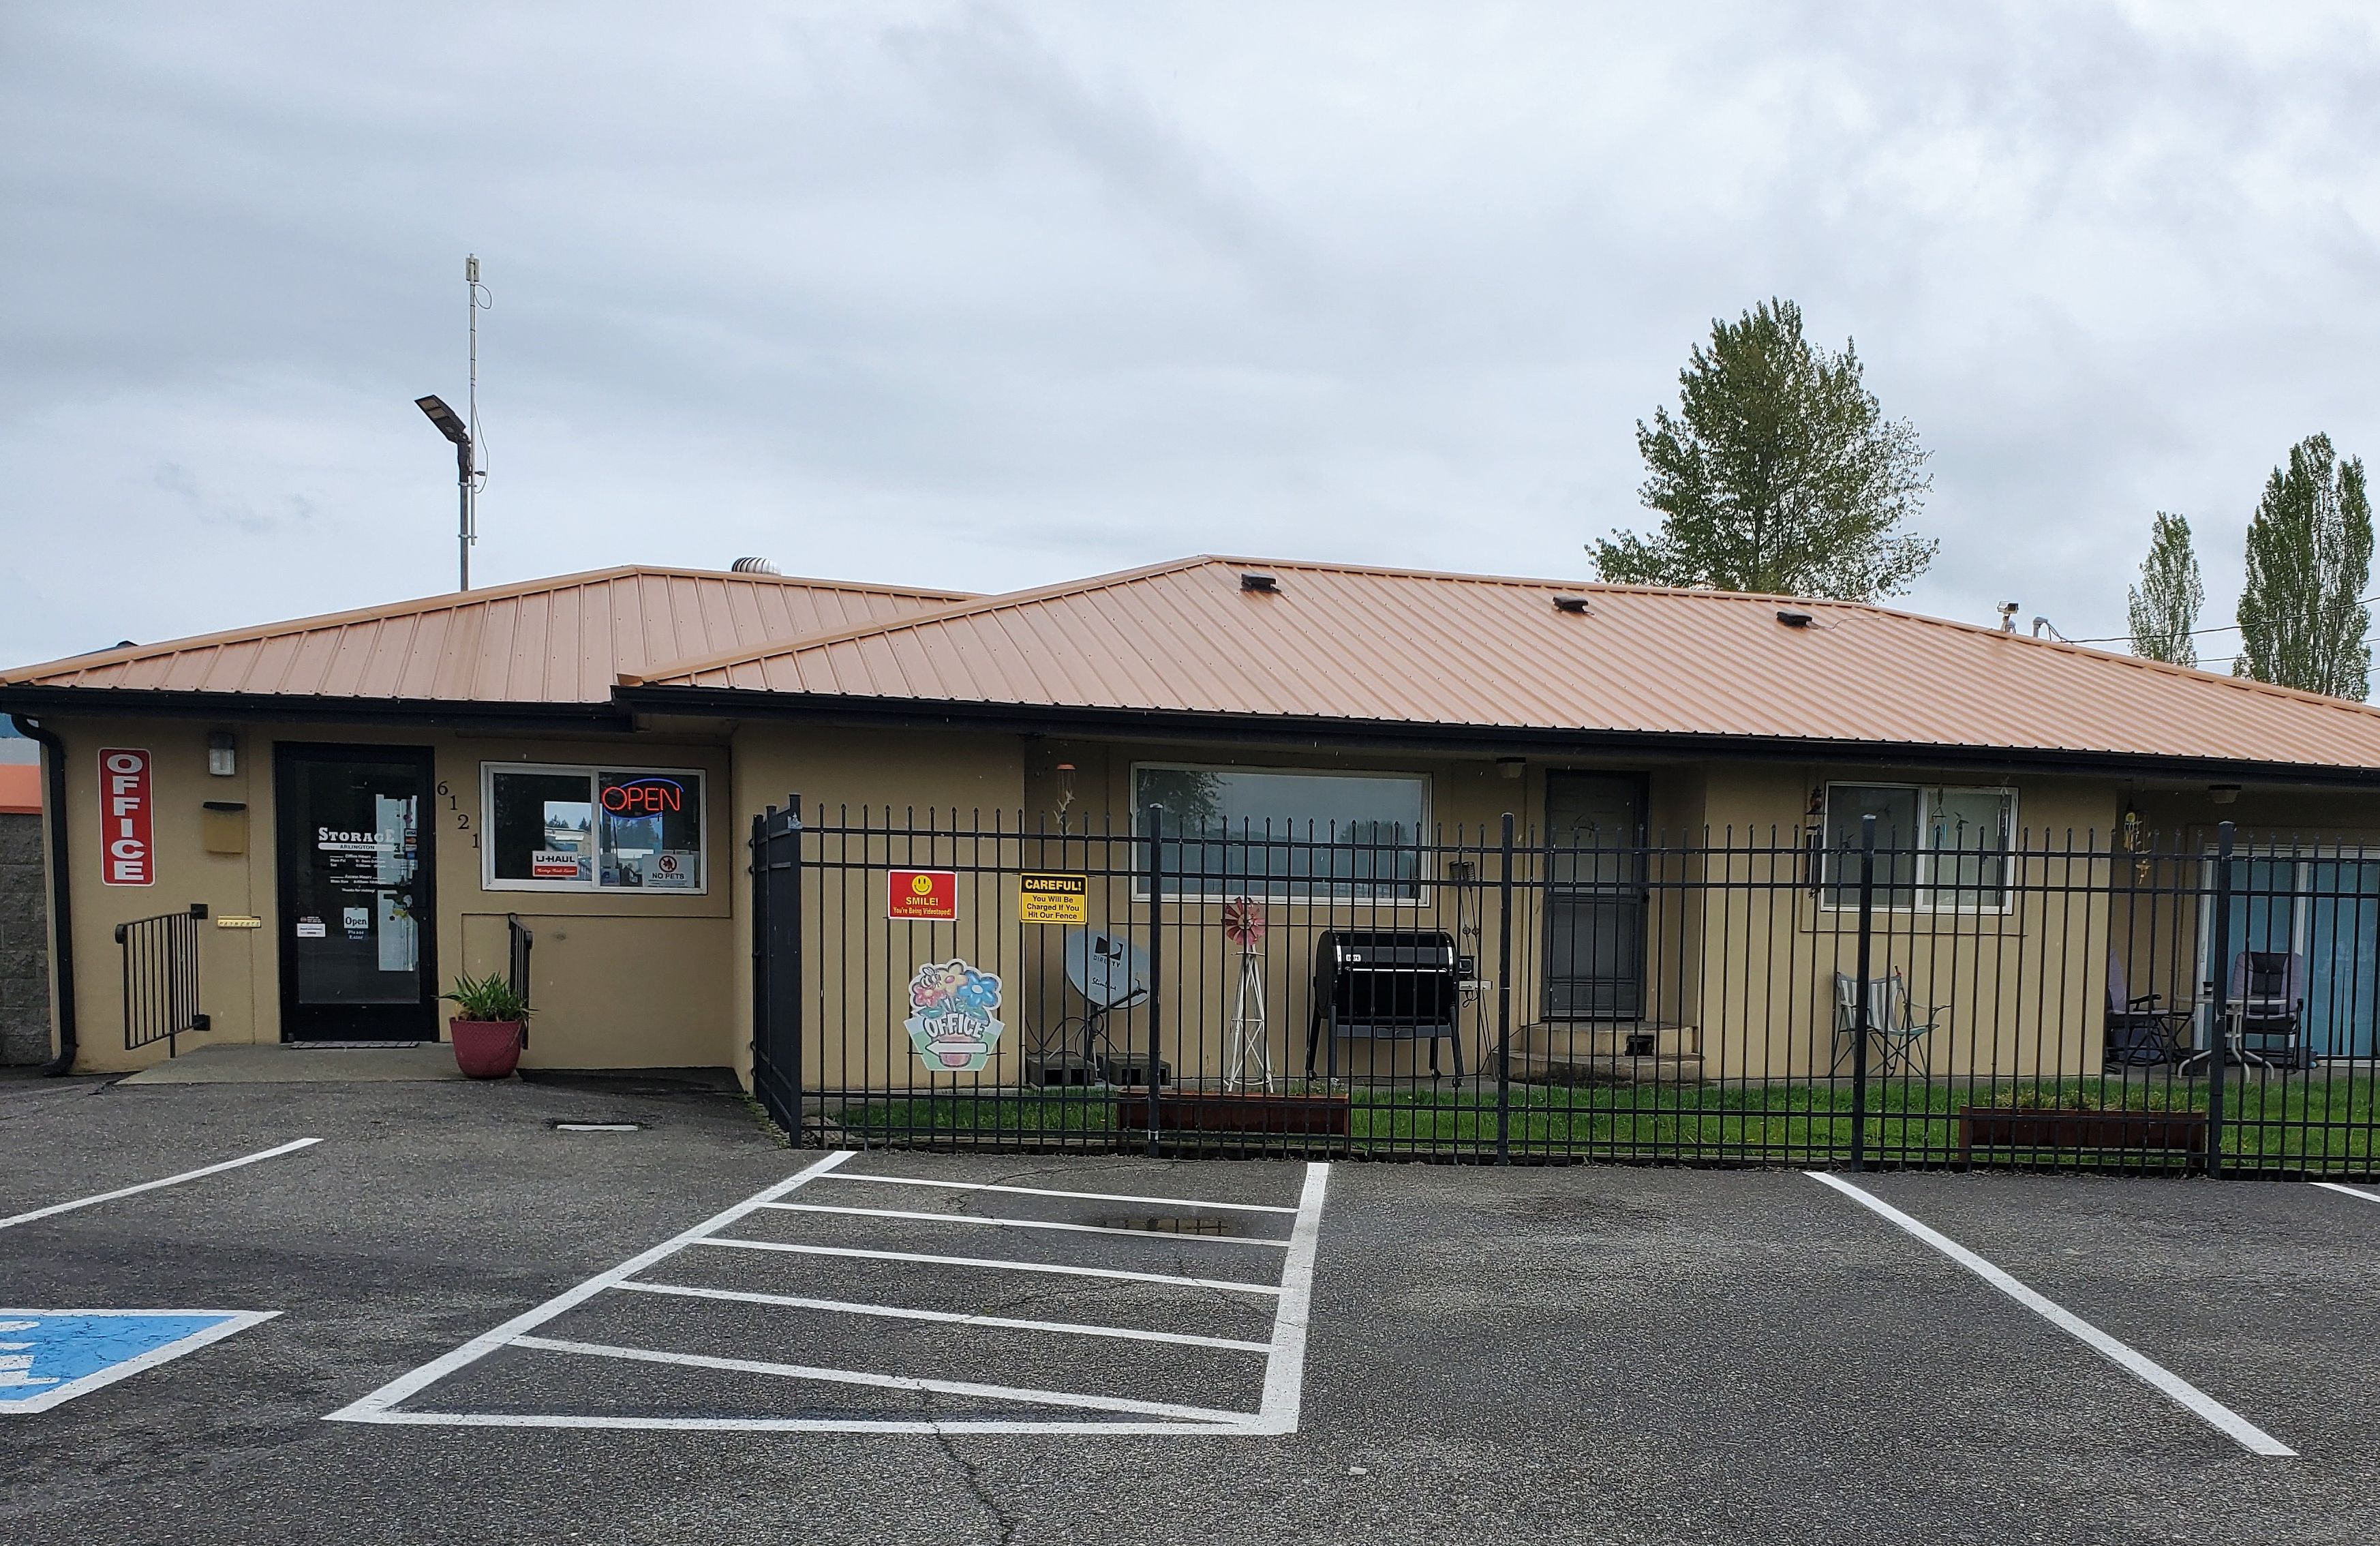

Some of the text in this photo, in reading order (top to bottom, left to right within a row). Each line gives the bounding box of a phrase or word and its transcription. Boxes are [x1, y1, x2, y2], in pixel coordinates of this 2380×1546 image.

[602, 786, 681, 811] OPEN
[106, 754, 145, 881] OFFICE
[1025, 879, 1082, 892] CAREFUL!
[906, 896, 939, 906] SMILE!
[1026, 903, 1057, 911] Charged
[893, 906, 952, 916] You're Being Videotaped!
[345, 916, 367, 927] Open
[1093, 955, 1120, 968] DIRETV
[924, 1013, 984, 1039] OFFICE
